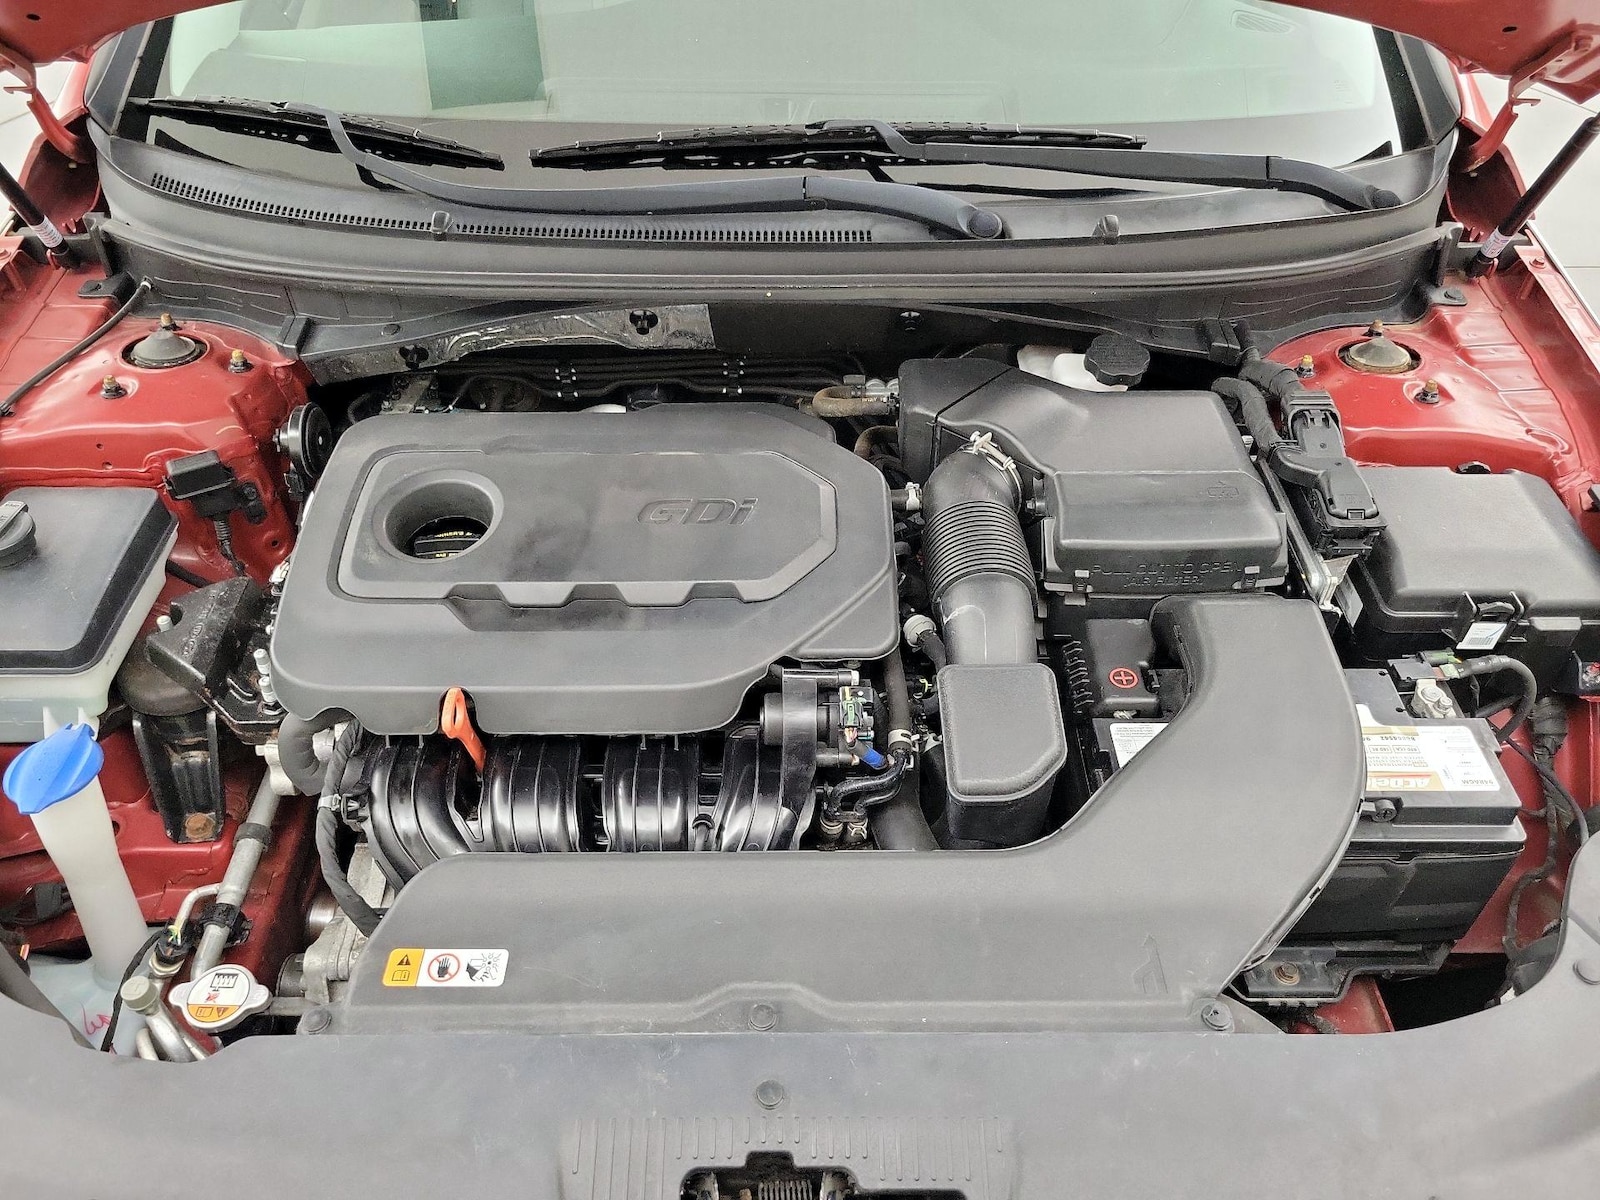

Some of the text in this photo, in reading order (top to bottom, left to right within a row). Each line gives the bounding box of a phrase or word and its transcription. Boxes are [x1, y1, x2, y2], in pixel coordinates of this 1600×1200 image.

[637, 497, 759, 525] GDi
[1091, 561, 1243, 575] PULL OUT TO OPEN
